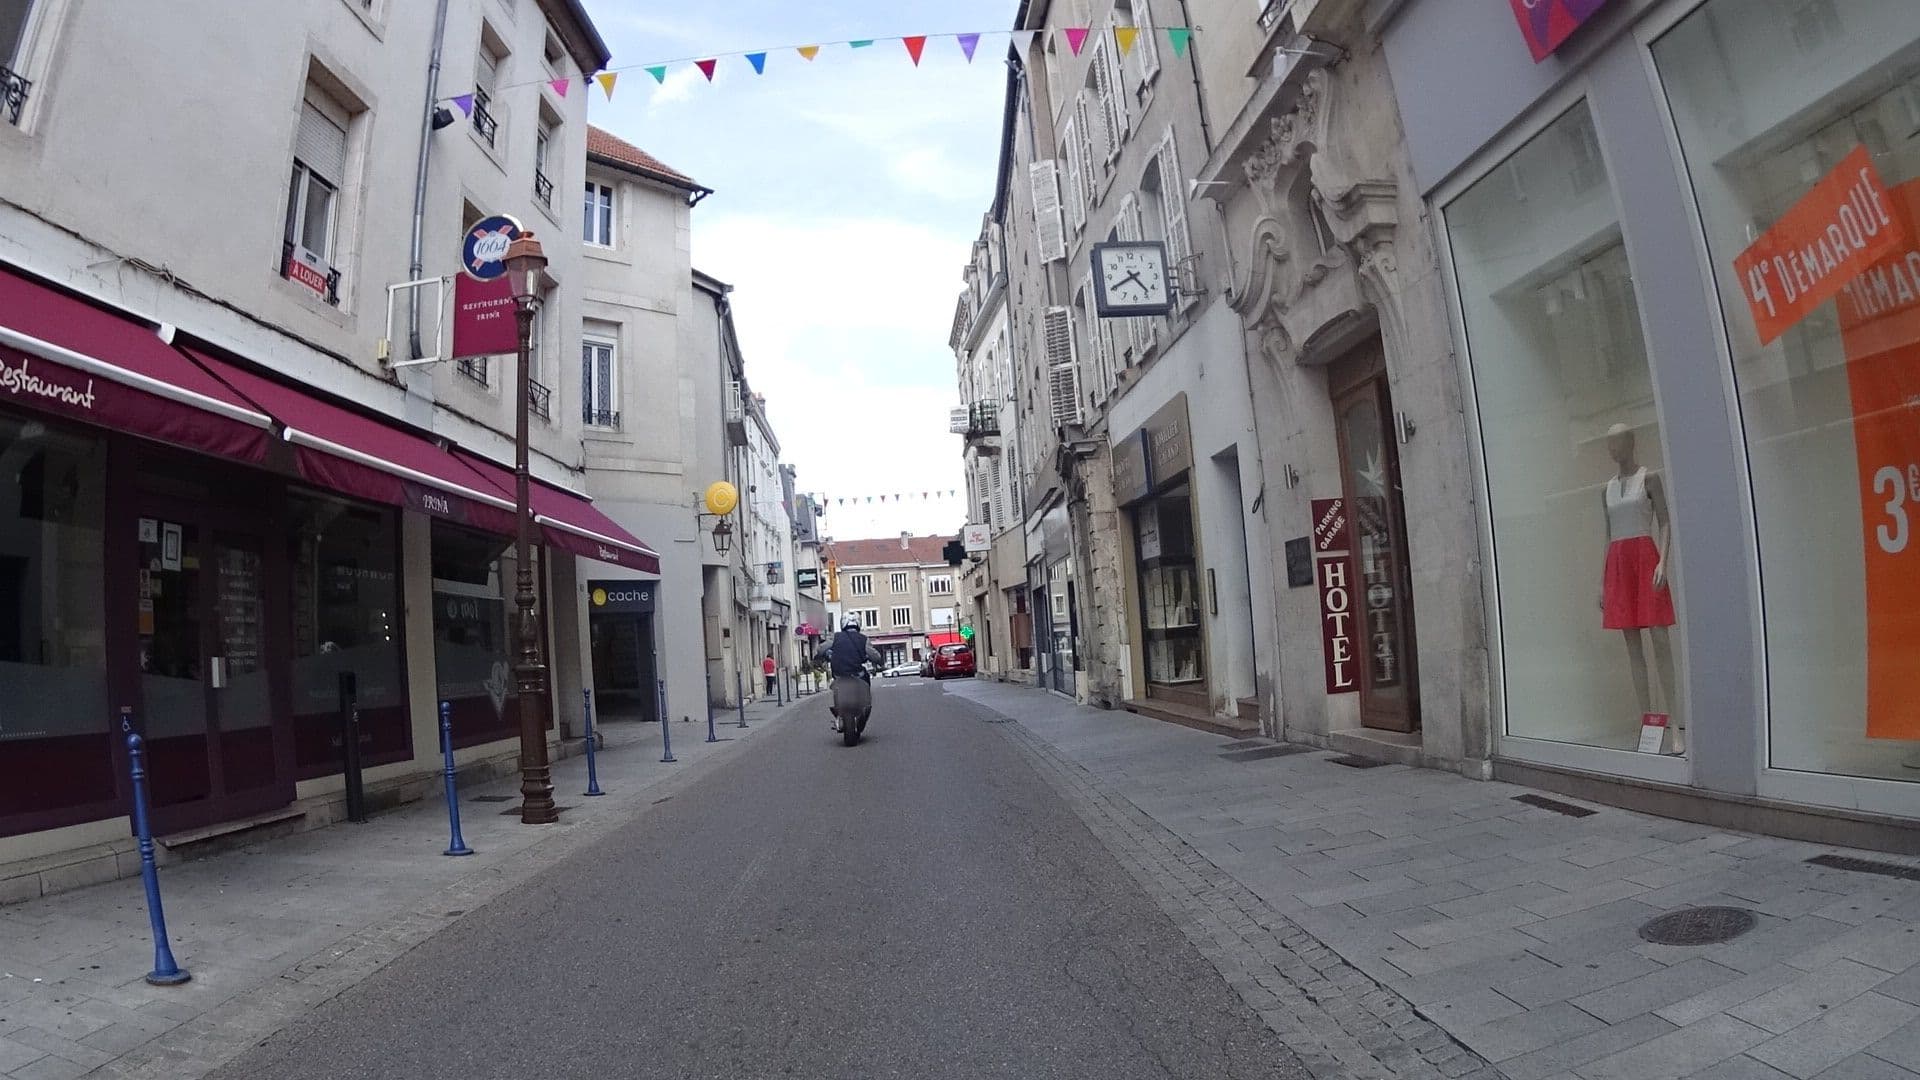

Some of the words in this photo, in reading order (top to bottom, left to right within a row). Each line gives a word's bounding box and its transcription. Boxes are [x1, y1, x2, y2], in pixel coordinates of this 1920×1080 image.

[1772, 167, 1890, 304] DÉMARQUE
[300, 266, 324, 290] LOUER
[1315, 500, 1342, 535] PARKING
[1320, 516, 1345, 549] GARAGE
[608, 590, 649, 601] cache
[1323, 562, 1352, 687] HOTEL
